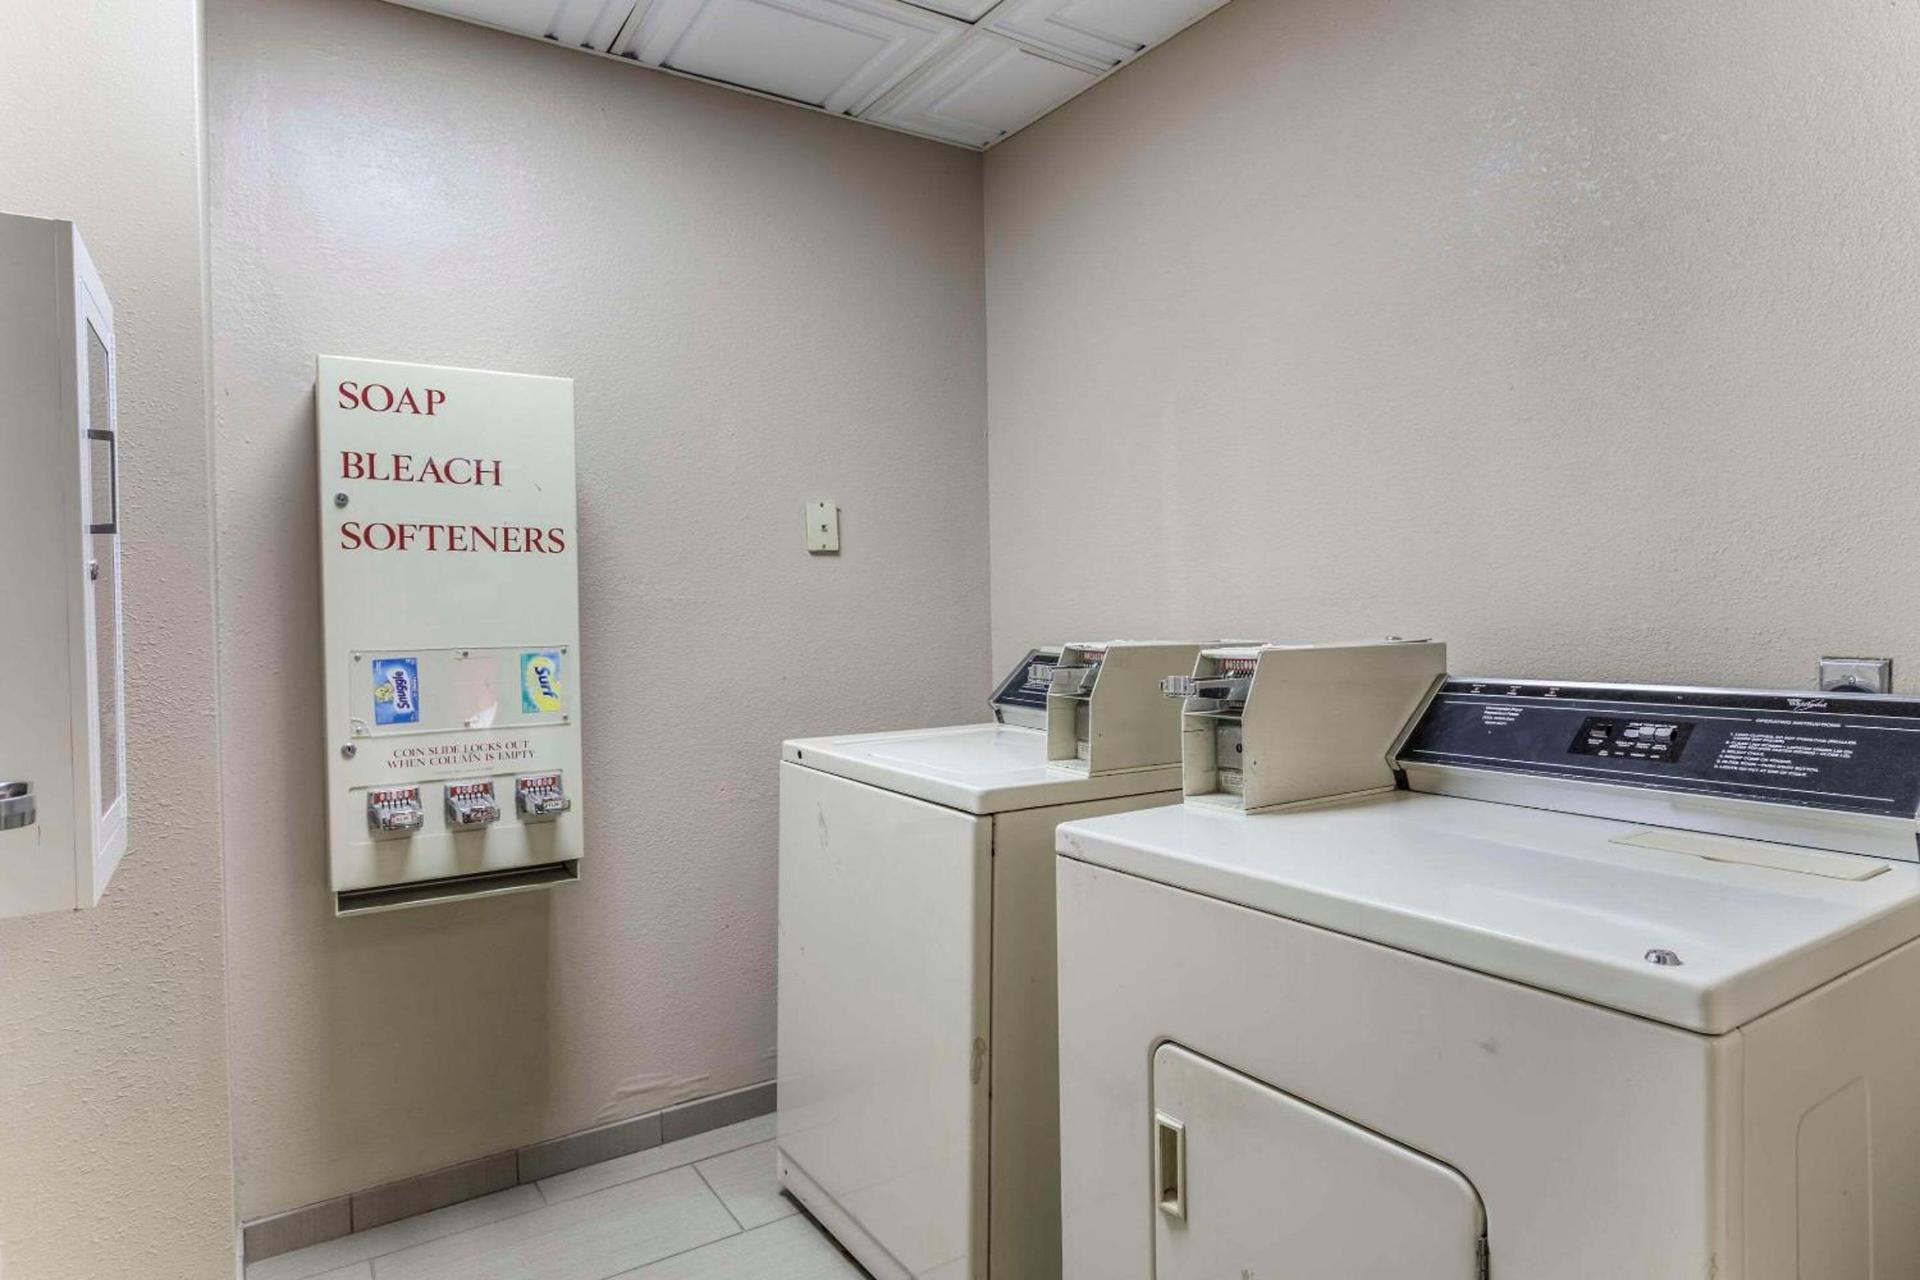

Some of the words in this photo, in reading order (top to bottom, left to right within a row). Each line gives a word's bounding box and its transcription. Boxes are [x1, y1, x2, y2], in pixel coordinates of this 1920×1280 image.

[338, 381, 446, 416] SOAP
[340, 451, 503, 486] BLEACH
[340, 521, 565, 554] SOFTENERS
[392, 671, 410, 709] Snuggle
[535, 666, 559, 699] Surf
[387, 758, 426, 769] WHEN
[429, 753, 481, 766] COLUMN
[485, 752, 495, 761] IS
[498, 750, 535, 760] EMPTY
[393, 747, 425, 759] COIN
[428, 744, 459, 755] SLIDE
[463, 741, 502, 752] LOCKS
[505, 740, 530, 749] OUT
